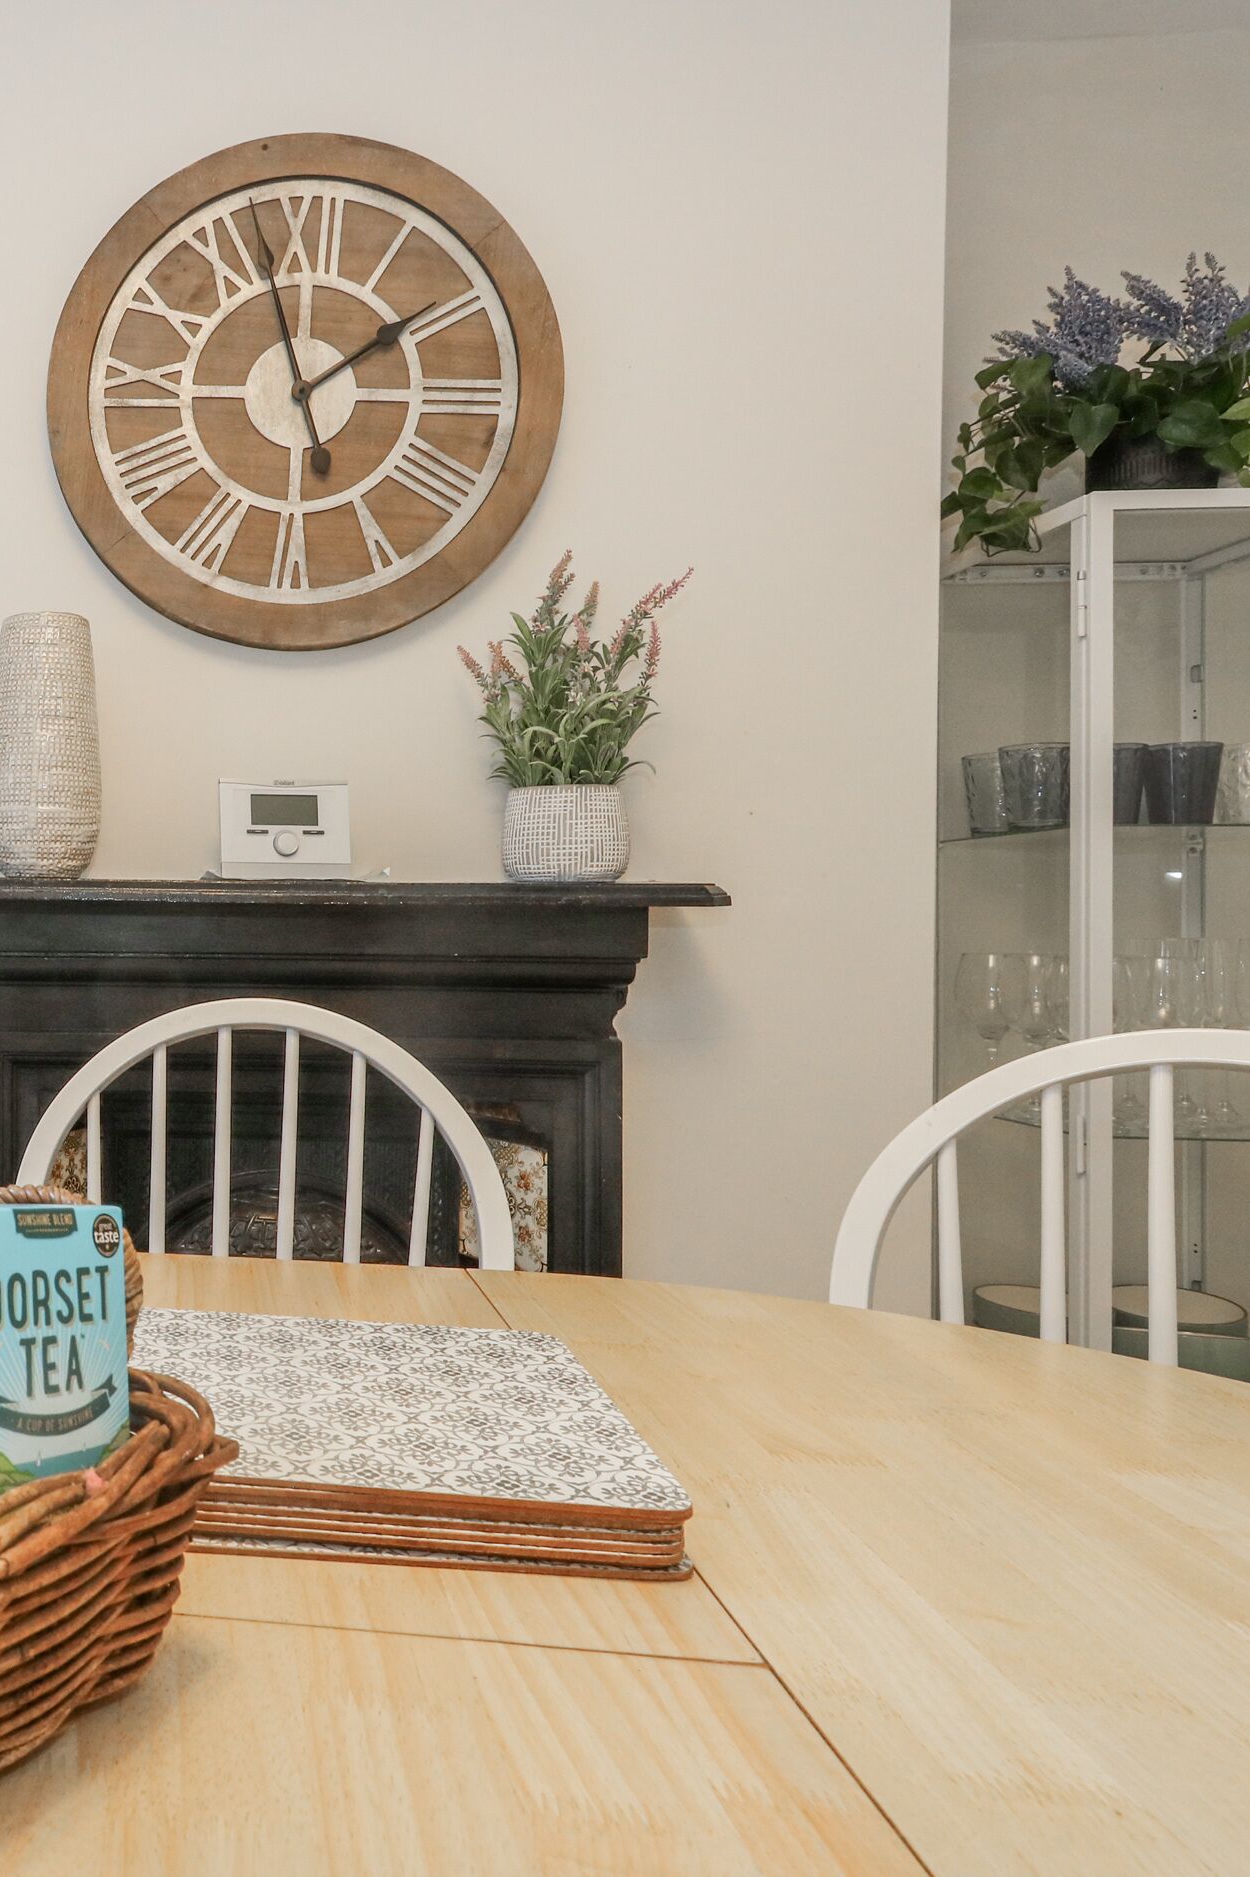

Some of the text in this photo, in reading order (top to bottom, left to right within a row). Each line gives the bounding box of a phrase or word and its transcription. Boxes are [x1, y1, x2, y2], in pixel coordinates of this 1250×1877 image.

[93, 1232, 119, 1244] taste
[19, 1335, 83, 1398] TEA
[26, 1419, 43, 1432] CUP
[57, 1408, 94, 1431] SUNSHINE
